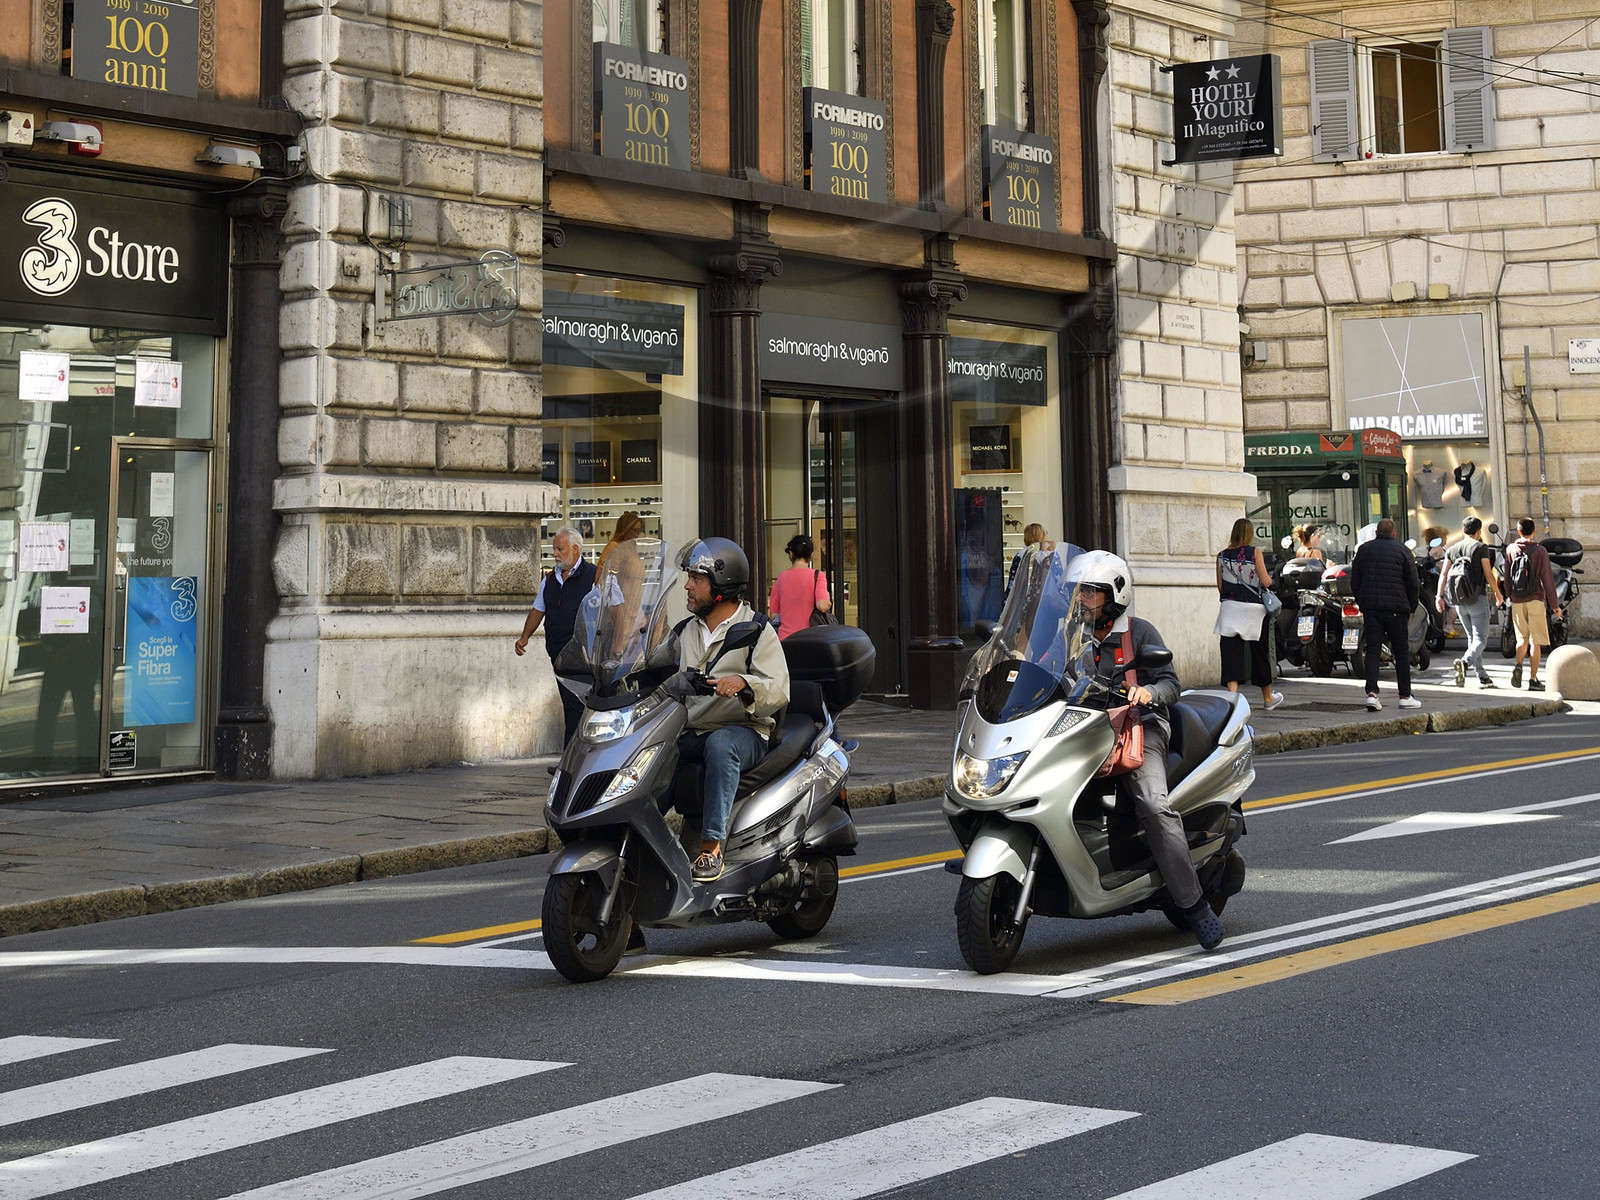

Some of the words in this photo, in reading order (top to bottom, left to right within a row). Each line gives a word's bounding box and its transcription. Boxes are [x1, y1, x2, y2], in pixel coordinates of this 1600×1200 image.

[143, 2, 169, 19] 2019
[105, 15, 169, 57] 100
[104, 57, 168, 91] anni
[605, 58, 687, 91] FORMENTO
[625, 86, 642, 100] 1919
[650, 91, 669, 105] 2019
[1190, 81, 1256, 104] HOTEL
[624, 103, 669, 137] 100
[813, 102, 884, 131] FORMENTO
[1192, 99, 1254, 121] YOURI
[830, 126, 845, 139] 1919
[852, 131, 868, 144] 2019
[1184, 124, 1194, 138] Il
[1197, 118, 1265, 139] Magnifico
[625, 138, 669, 166] anni
[830, 141, 869, 174] 100
[991, 139, 1053, 164] FORMENTO
[1006, 161, 1019, 172] 1919
[1025, 165, 1039, 175] 2019
[831, 173, 869, 200] anni
[1006, 175, 1040, 204] 100
[1008, 204, 1041, 229] anni
[19, 197, 82, 297] 3
[86, 226, 179, 284] Store
[621, 323, 631, 341] &
[769, 337, 838, 362] salmoiraghi
[840, 343, 849, 360] &
[947, 358, 999, 380] almoiraghi
[1000, 362, 1008, 378] &
[1247, 445, 1313, 456] FREDDA
[1276, 506, 1328, 519] LOCALE
[128, 558, 139, 566] the
[140, 557, 161, 566] future
[139, 641, 178, 660] Super
[139, 660, 171, 675] Fibra
